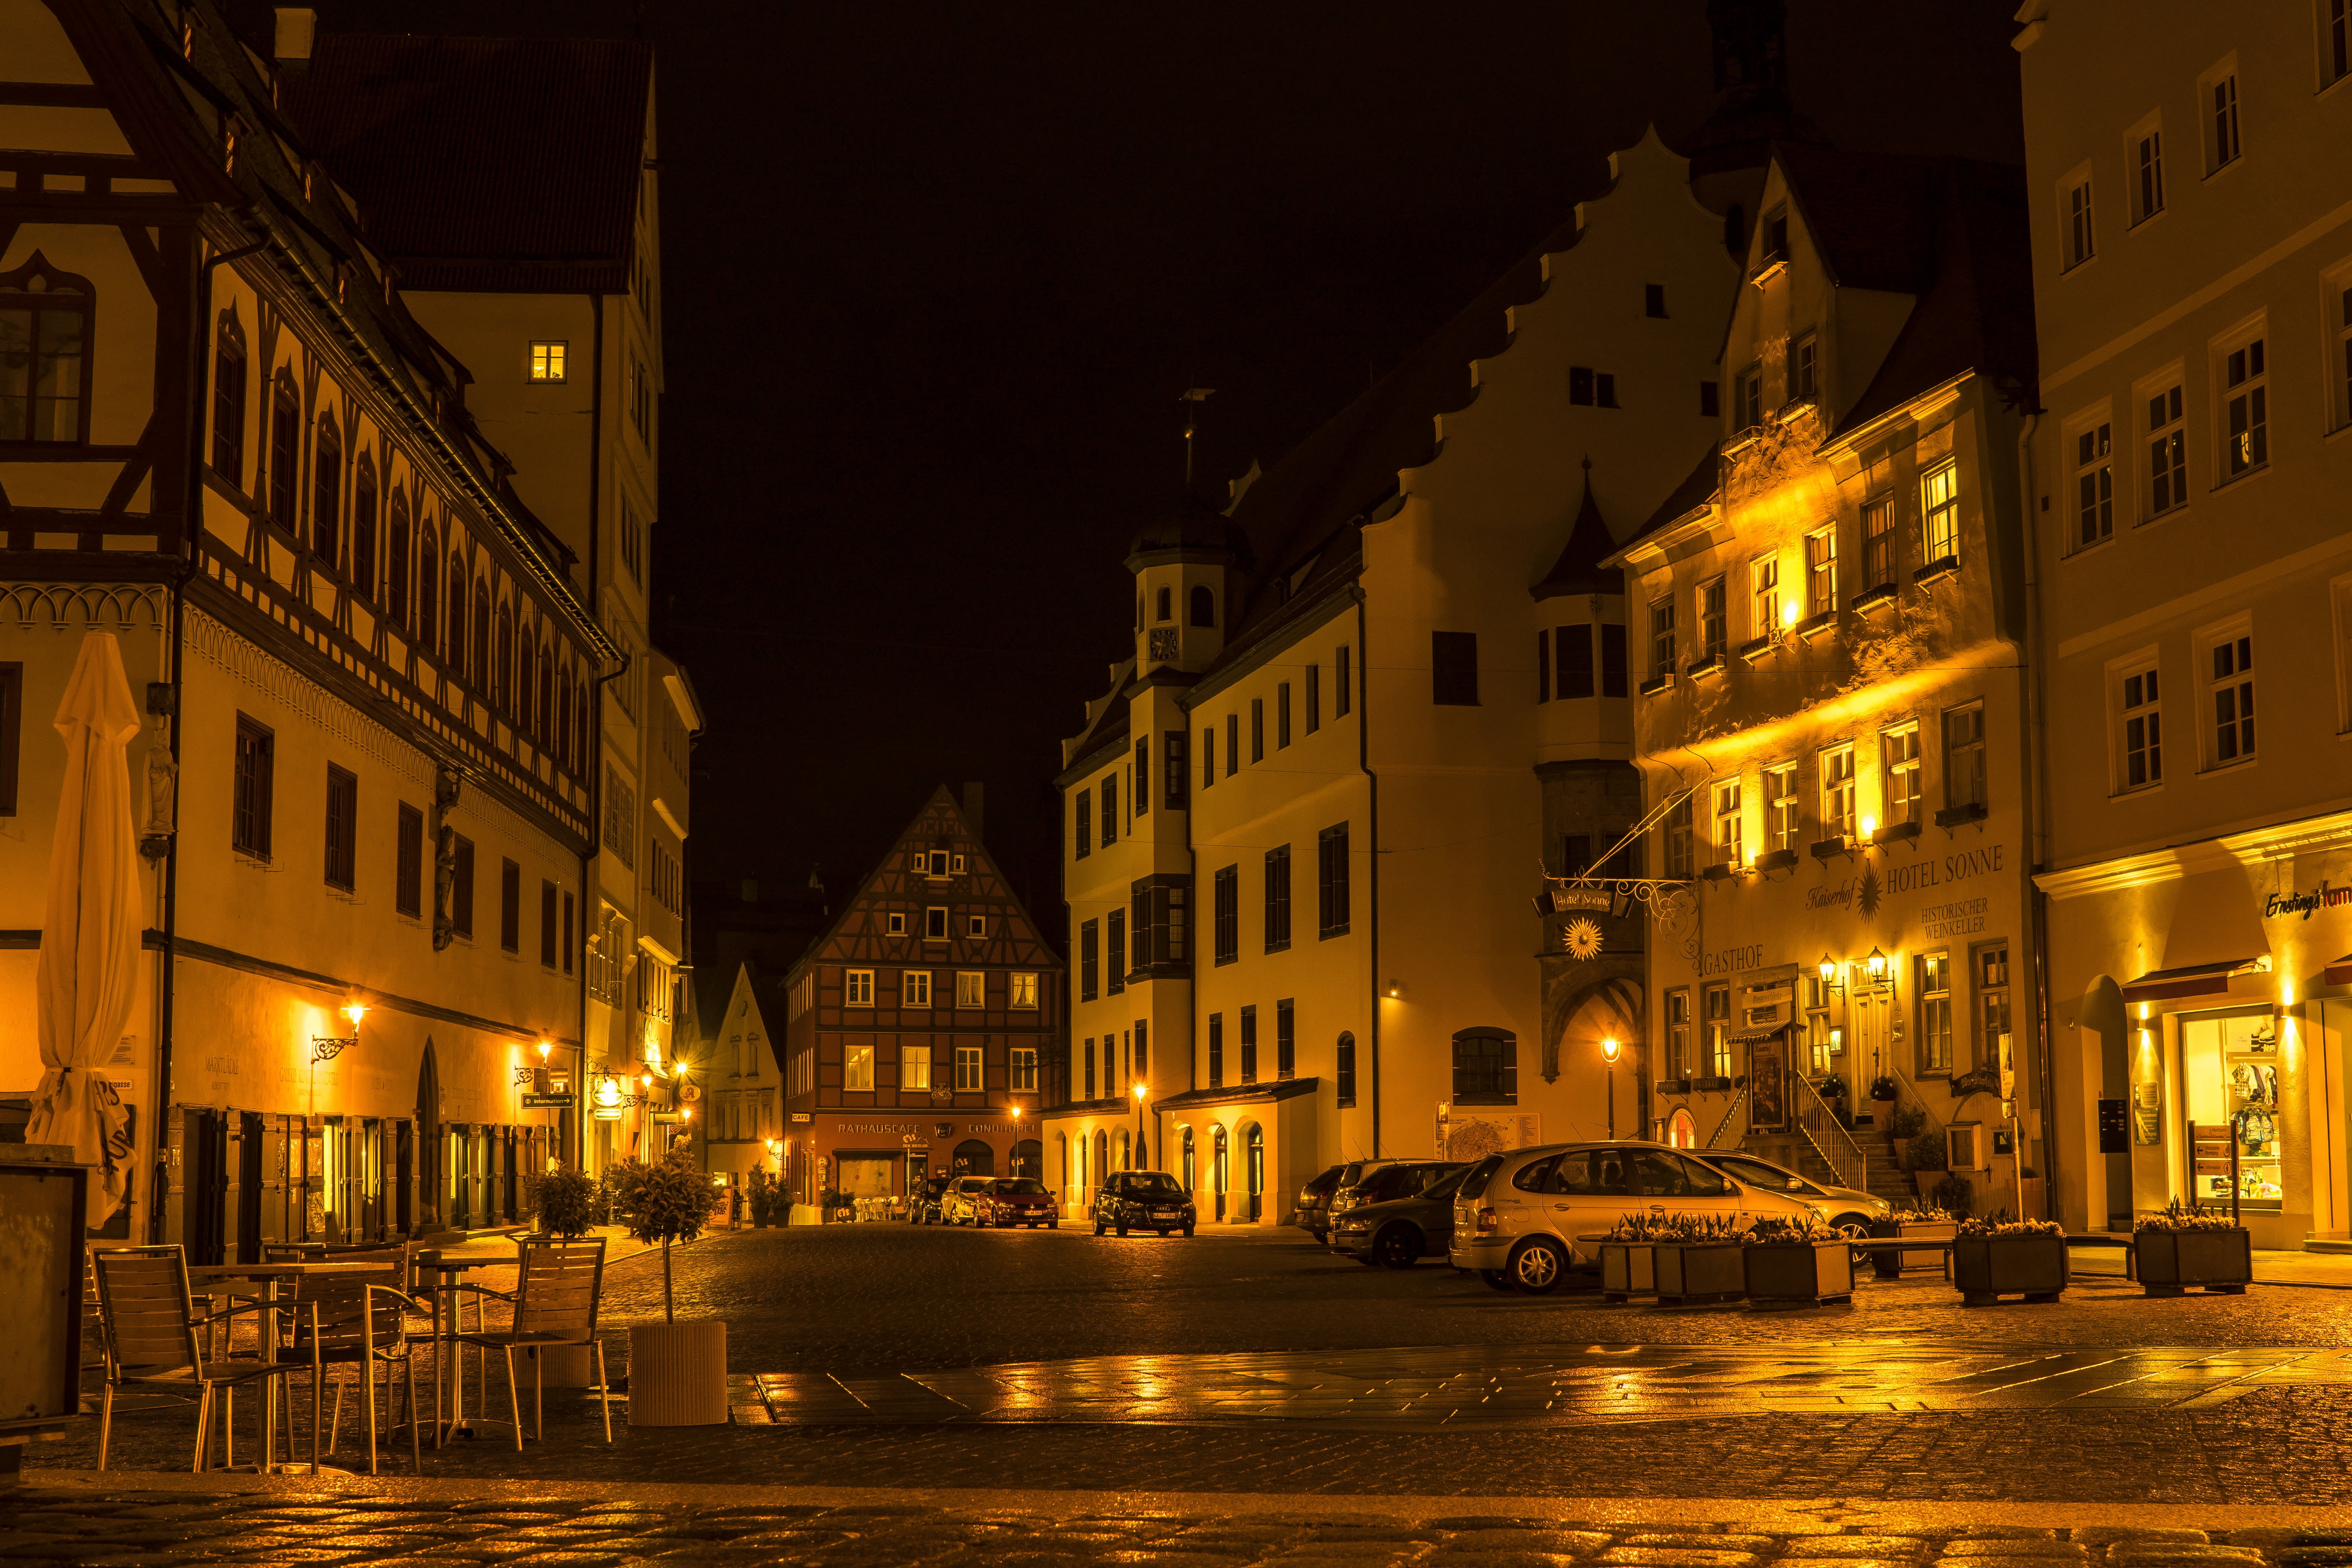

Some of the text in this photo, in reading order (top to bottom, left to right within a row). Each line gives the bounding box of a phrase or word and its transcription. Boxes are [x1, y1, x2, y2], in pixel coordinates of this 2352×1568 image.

[1806, 845, 2003, 911] Kaiserhof HOTEL SONNE
[1557, 894, 1610, 906] Hotel Sonne
[1921, 898, 1988, 924] HISTORISCHER
[2266, 880, 2352, 920] Ernsting's fam
[1925, 916, 1985, 940] WEINKELLER
[1704, 944, 1763, 975] GASTHOF
[838, 1124, 921, 1133] RATHAUSCAFE
[969, 1124, 1034, 1133] CONDITOREI
[2239, 1165, 2258, 1178] family
